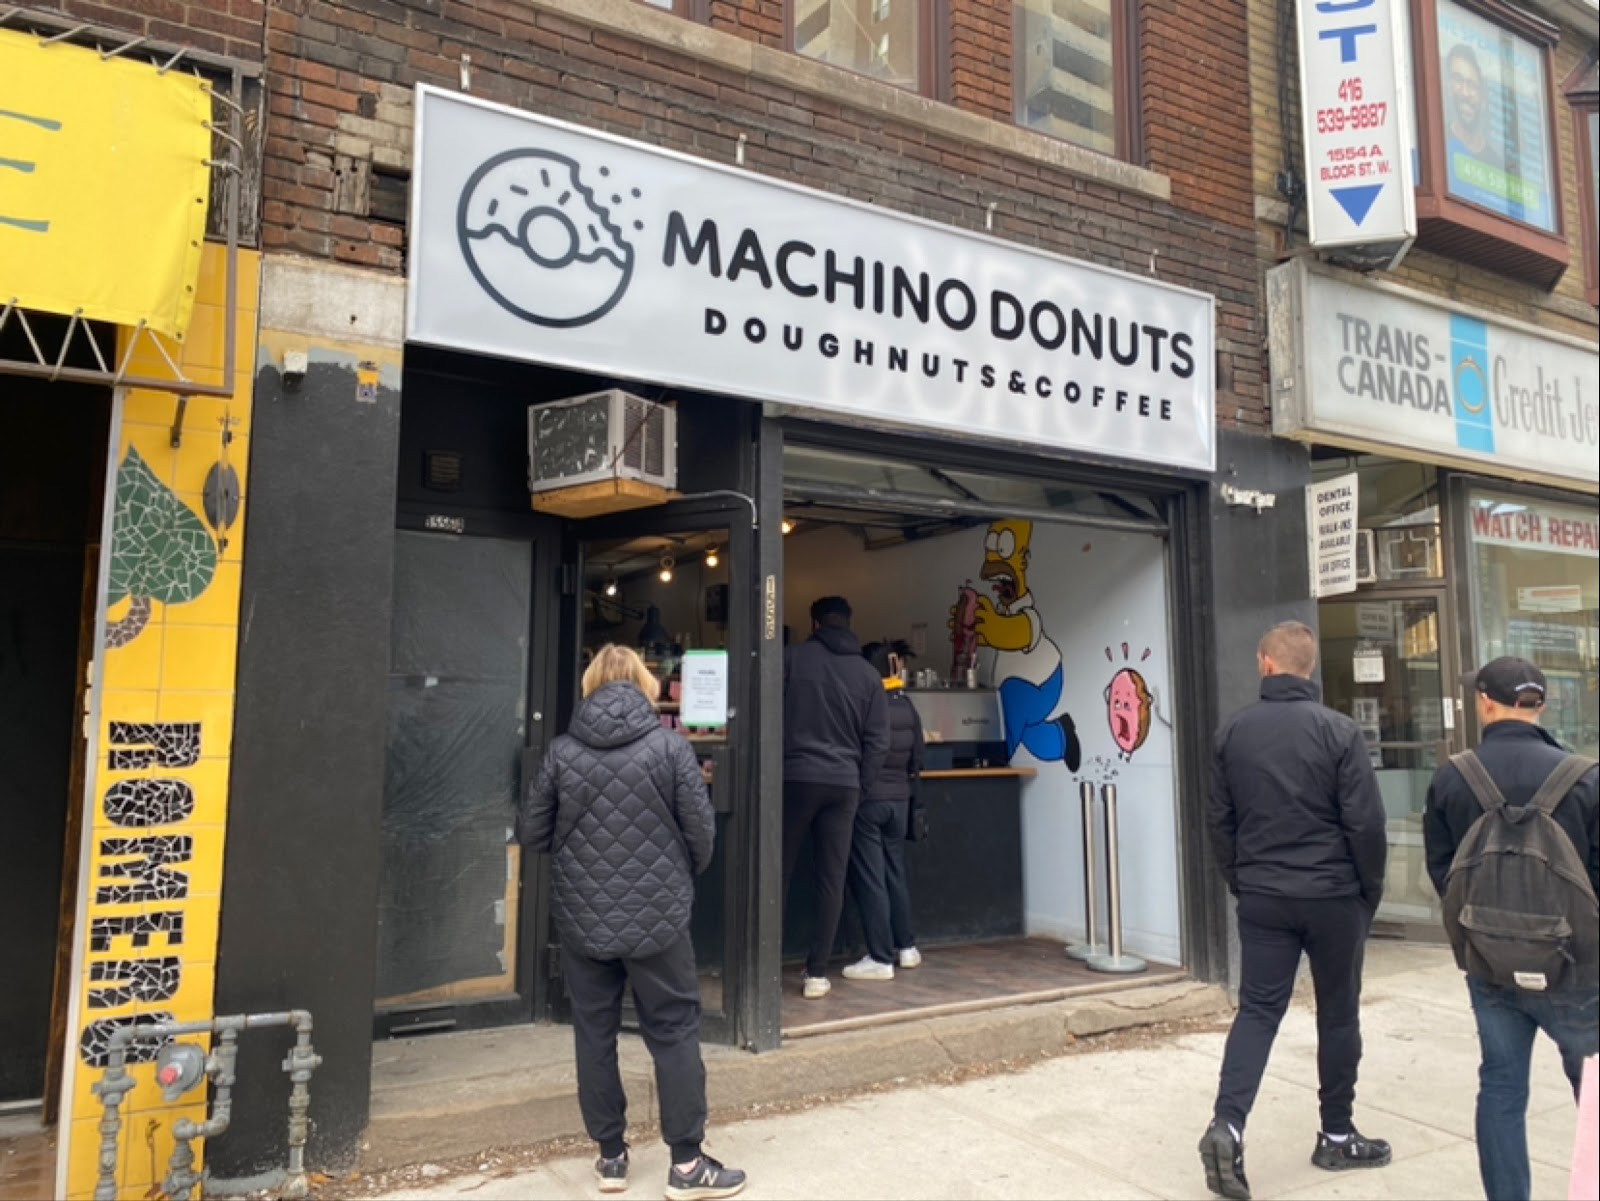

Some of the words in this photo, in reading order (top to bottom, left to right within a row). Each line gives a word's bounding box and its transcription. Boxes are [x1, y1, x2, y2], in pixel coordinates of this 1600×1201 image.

[1337, 77, 1363, 102] 416
[1317, 102, 1388, 134] 539-9887
[1320, 163, 1356, 181] BLOOR
[1359, 161, 1376, 177] ST.
[662, 210, 977, 330] MACHINO
[991, 289, 1195, 379] DONUTS
[704, 308, 1172, 421] DOUGHNUTS&COFFEE
[1337, 356, 1453, 417] CANADA
[1493, 354, 1567, 440] Credit
[1317, 486, 1353, 504] DENTAL
[1319, 500, 1352, 517] OFFICE
[1471, 507, 1542, 543] WATCH
[80, 721, 202, 1068] ROMERO
